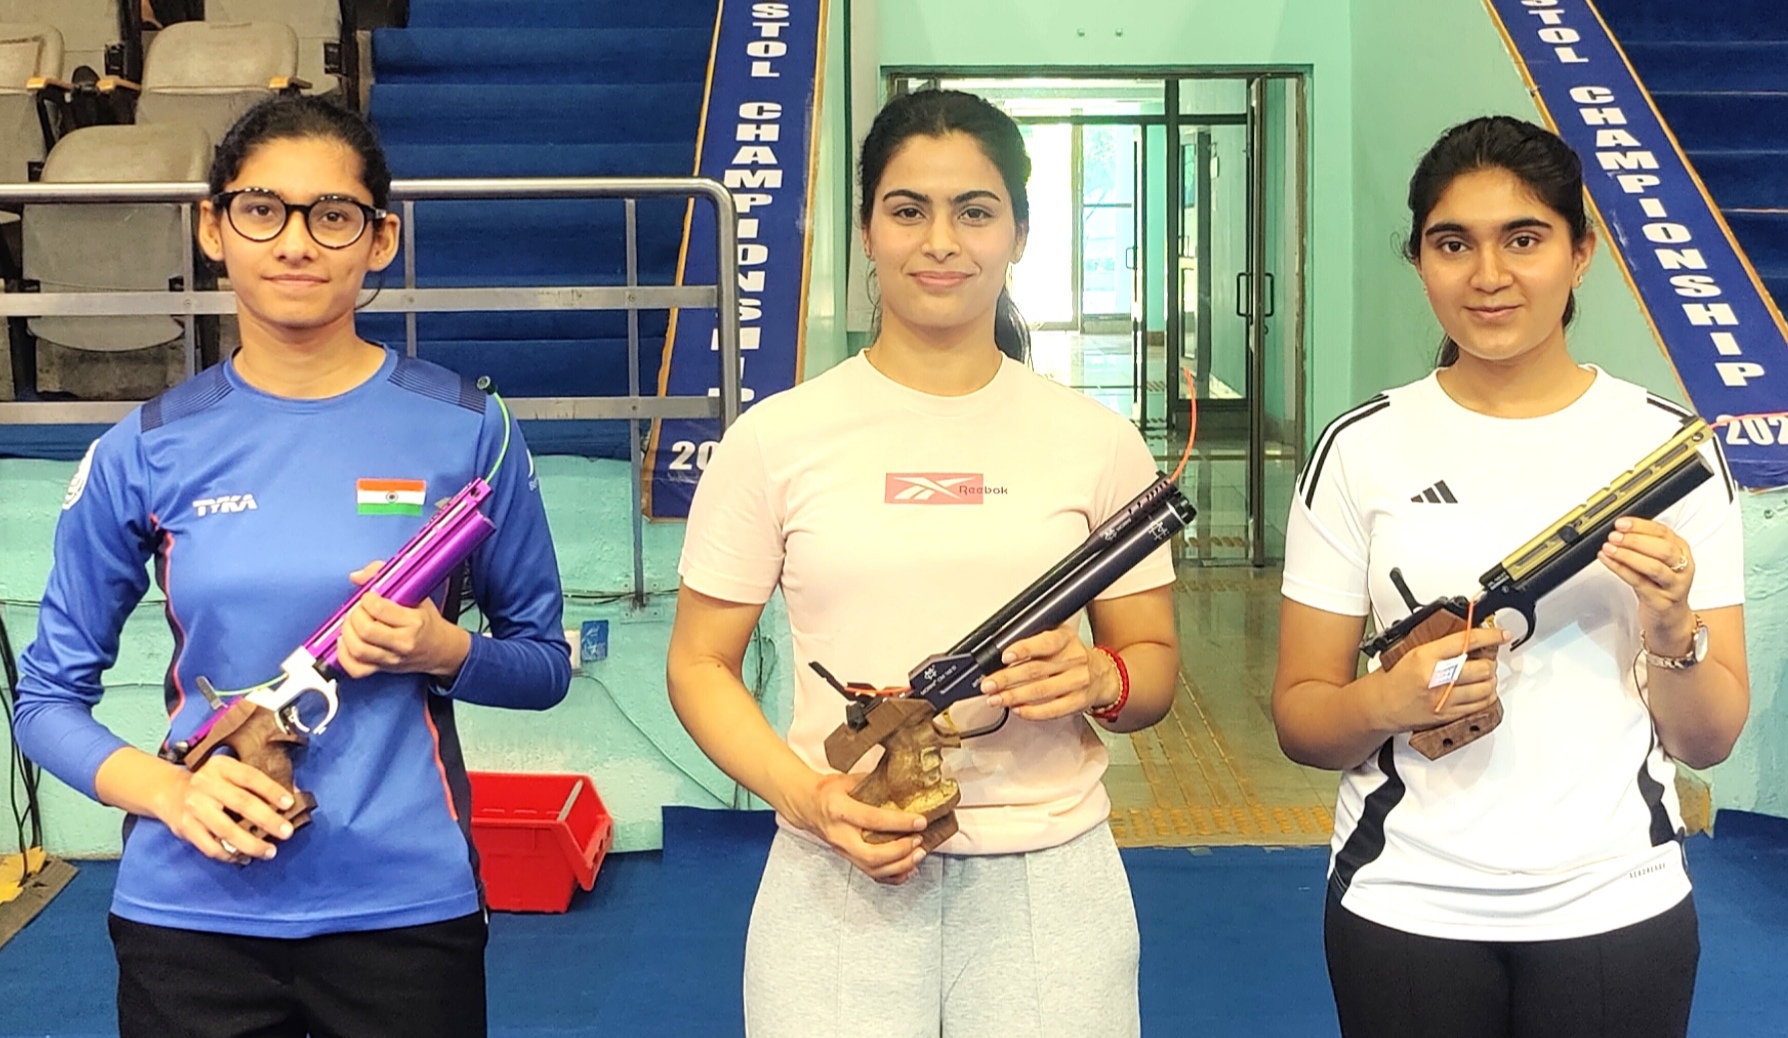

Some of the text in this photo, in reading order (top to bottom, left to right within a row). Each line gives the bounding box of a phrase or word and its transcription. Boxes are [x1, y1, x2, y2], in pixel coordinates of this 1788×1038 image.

[747, 3, 790, 77] STOL
[1569, 86, 1765, 387] CHAMPIONSHIP
[193, 493, 258, 517] TYKA
[959, 485, 1008, 495] Reebok
